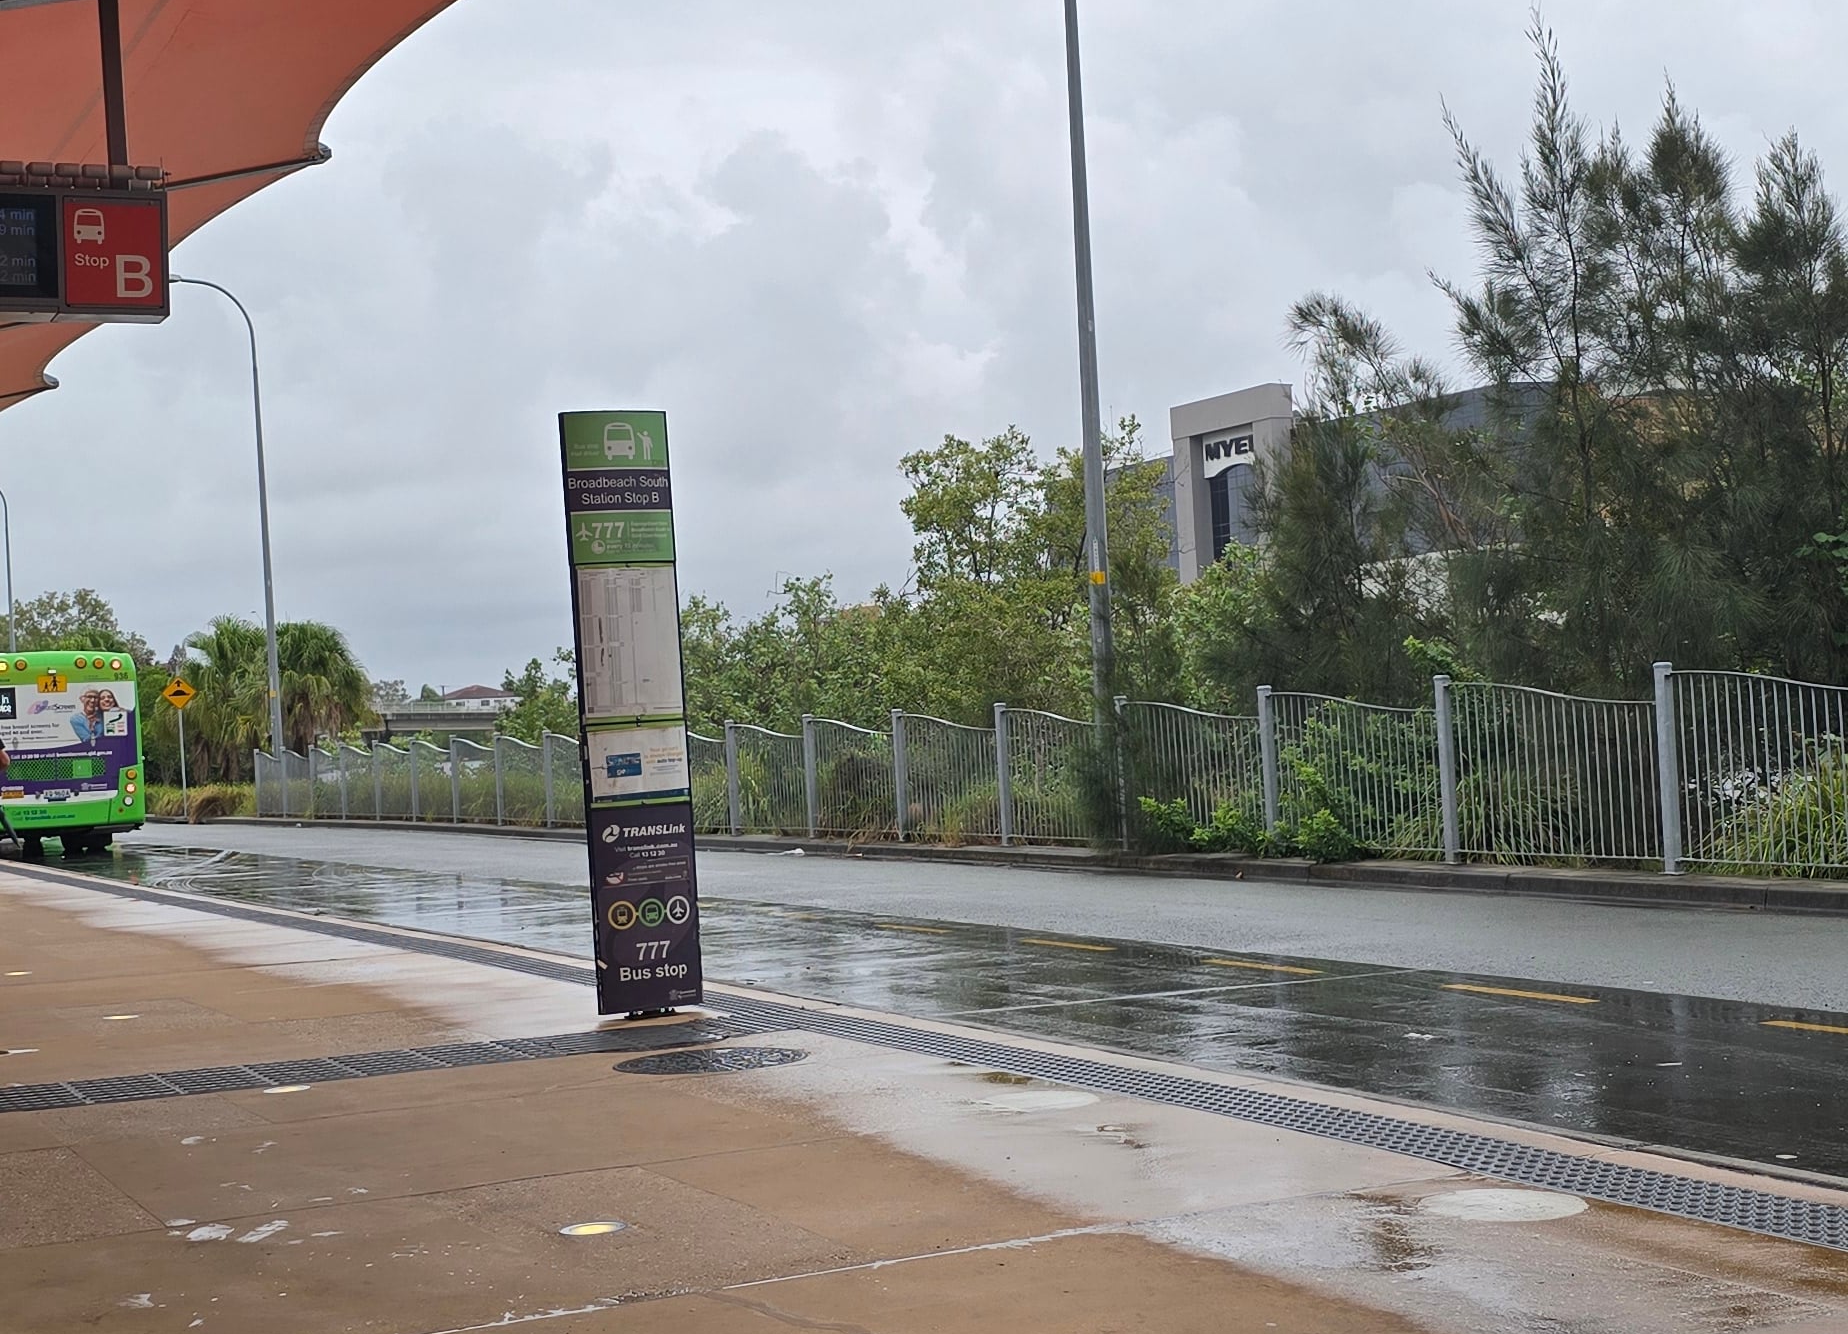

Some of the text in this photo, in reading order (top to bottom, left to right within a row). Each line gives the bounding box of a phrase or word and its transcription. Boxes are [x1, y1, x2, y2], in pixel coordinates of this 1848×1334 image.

[10, 209, 35, 220] min
[10, 225, 35, 236] min
[11, 256, 36, 267] min
[12, 271, 37, 282] min
[74, 253, 153, 298] Stop B
[568, 475, 669, 490] Broadbeach South
[581, 491, 660, 506] Station Stop B
[592, 521, 625, 539] 777
[622, 823, 686, 839] TRANSLink
[636, 940, 671, 961] 777
[619, 963, 688, 982] Bus stop
